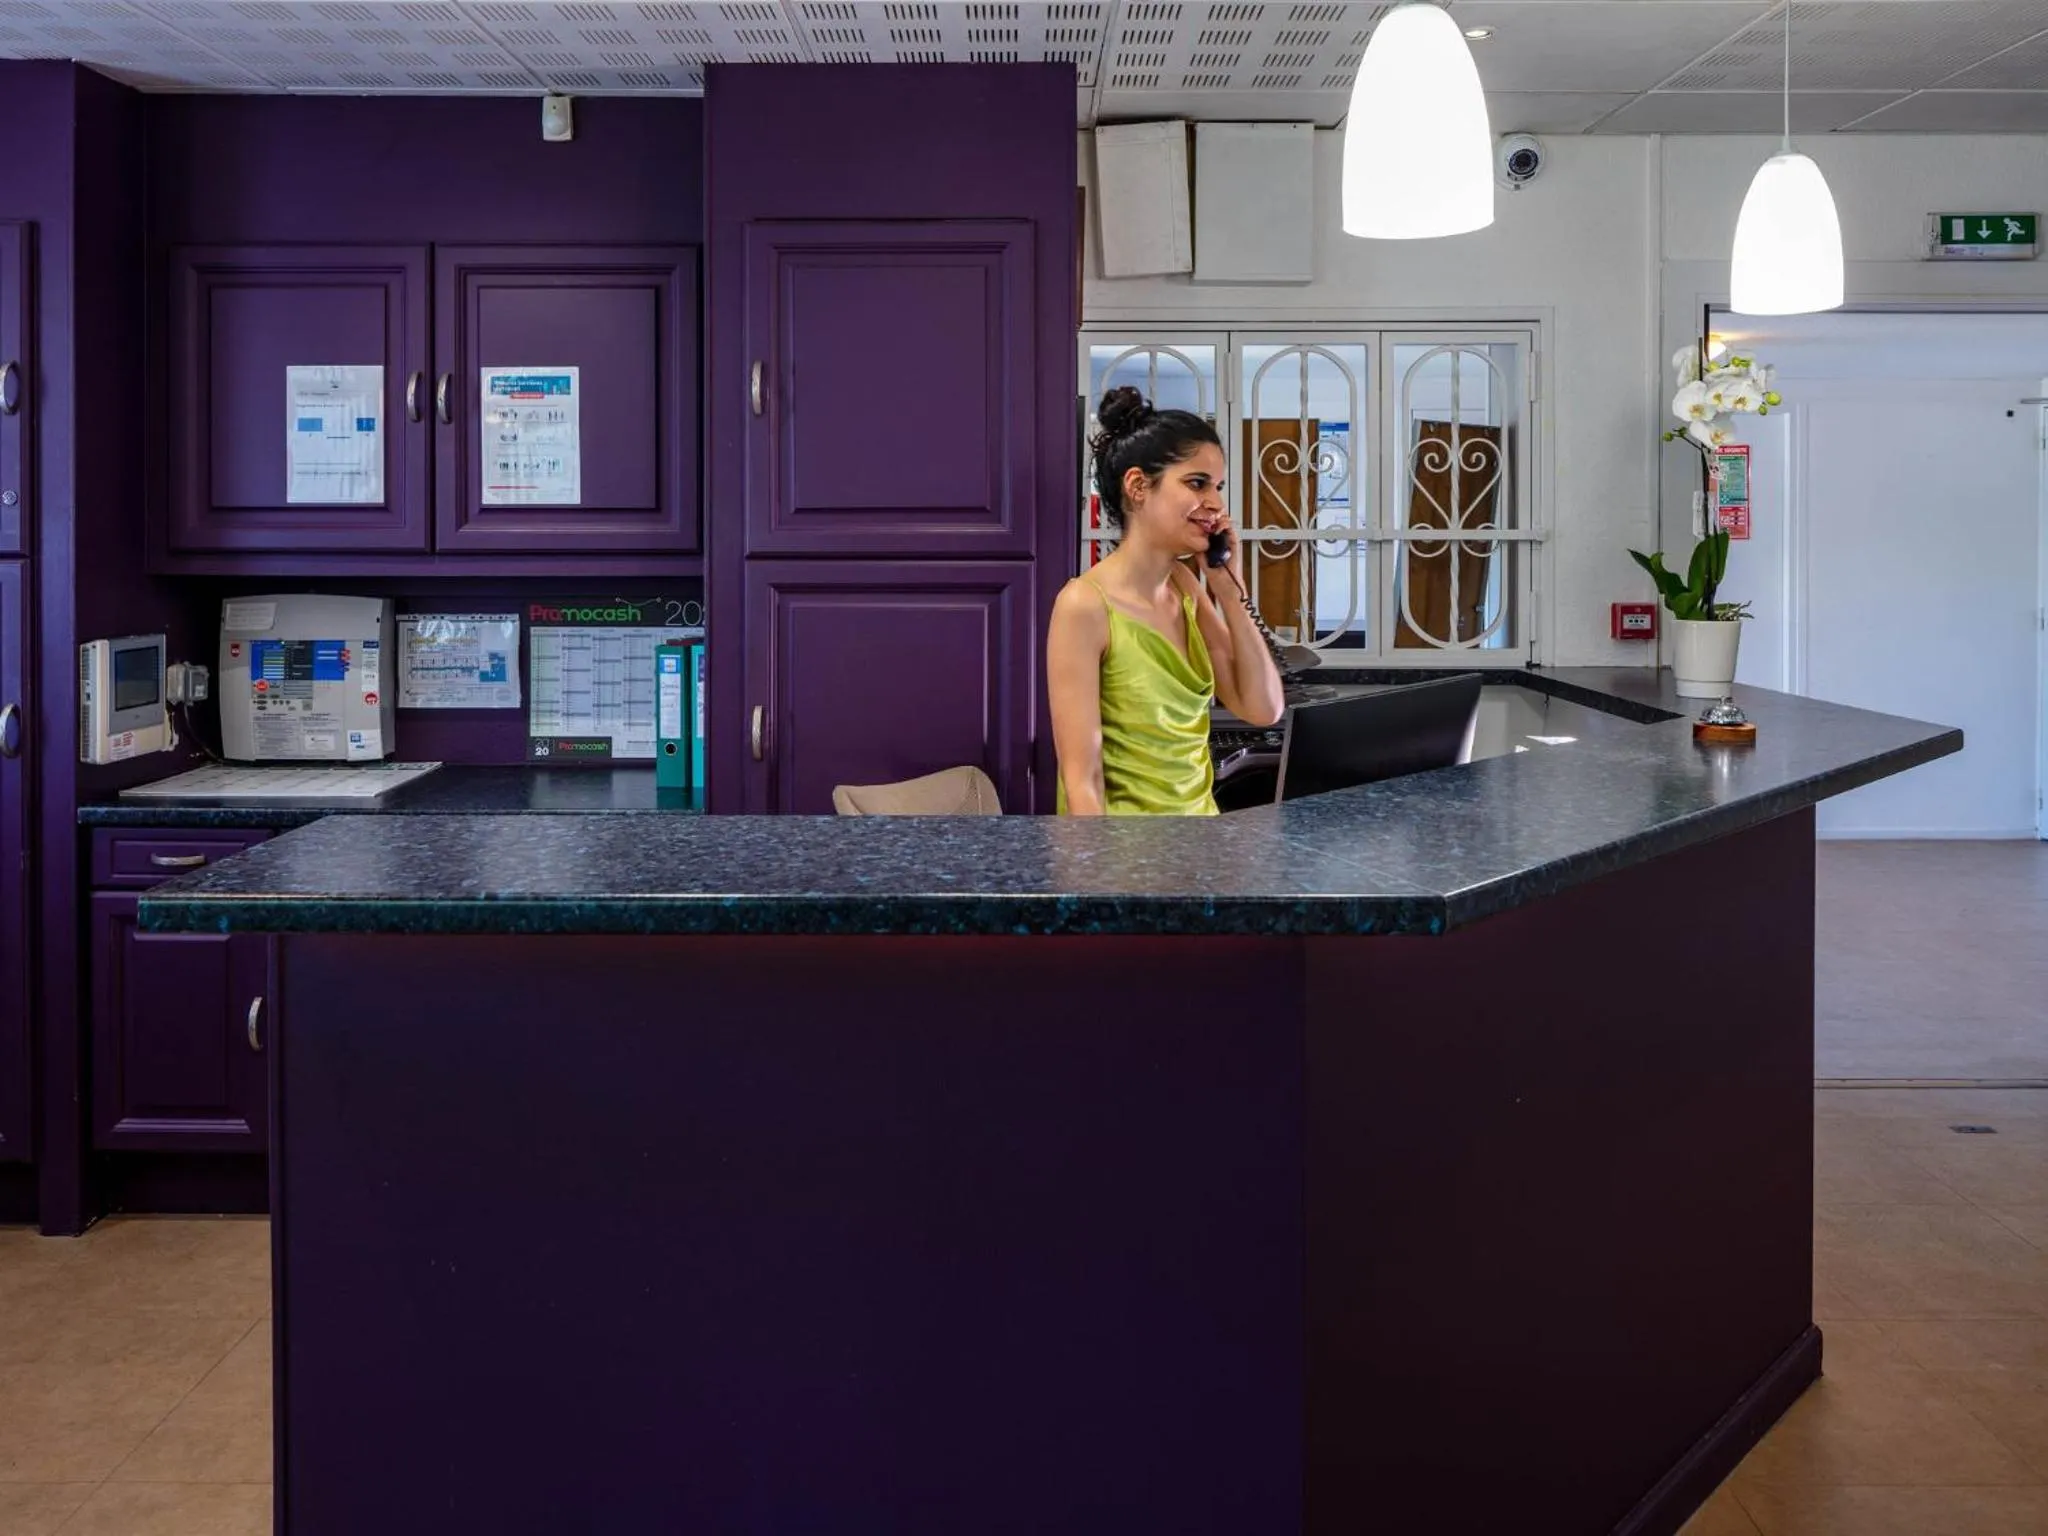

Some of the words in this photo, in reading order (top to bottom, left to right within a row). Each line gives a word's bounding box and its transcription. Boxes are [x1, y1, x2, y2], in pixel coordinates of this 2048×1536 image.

[530, 604, 641, 621] Promocash
[664, 600, 704, 626] 20
[558, 742, 608, 751] Promocash
[535, 747, 549, 756] 20
